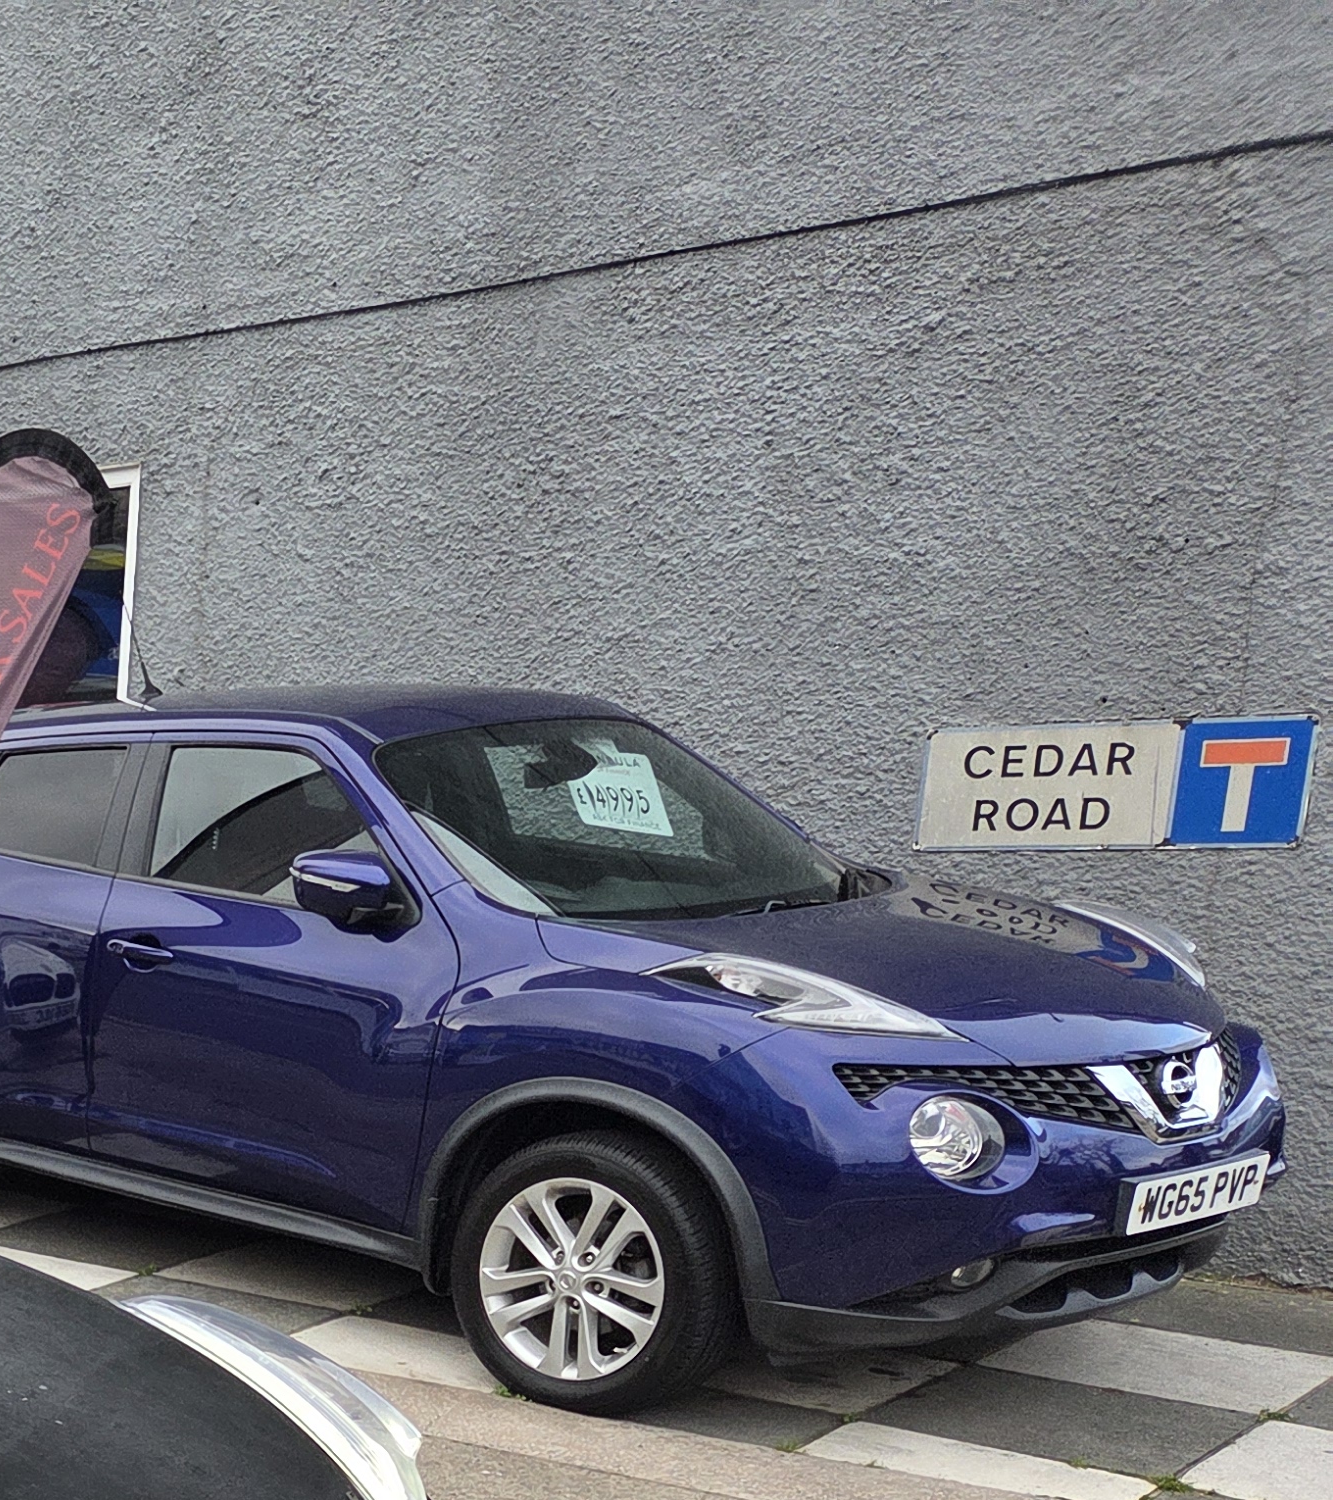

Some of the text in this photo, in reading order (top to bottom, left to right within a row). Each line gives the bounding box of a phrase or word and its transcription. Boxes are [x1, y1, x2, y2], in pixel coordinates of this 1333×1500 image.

[964, 742, 1136, 779] CEDAR
[972, 797, 1111, 832] ROAD
[1141, 1164, 1258, 1224] WG65 PVP
